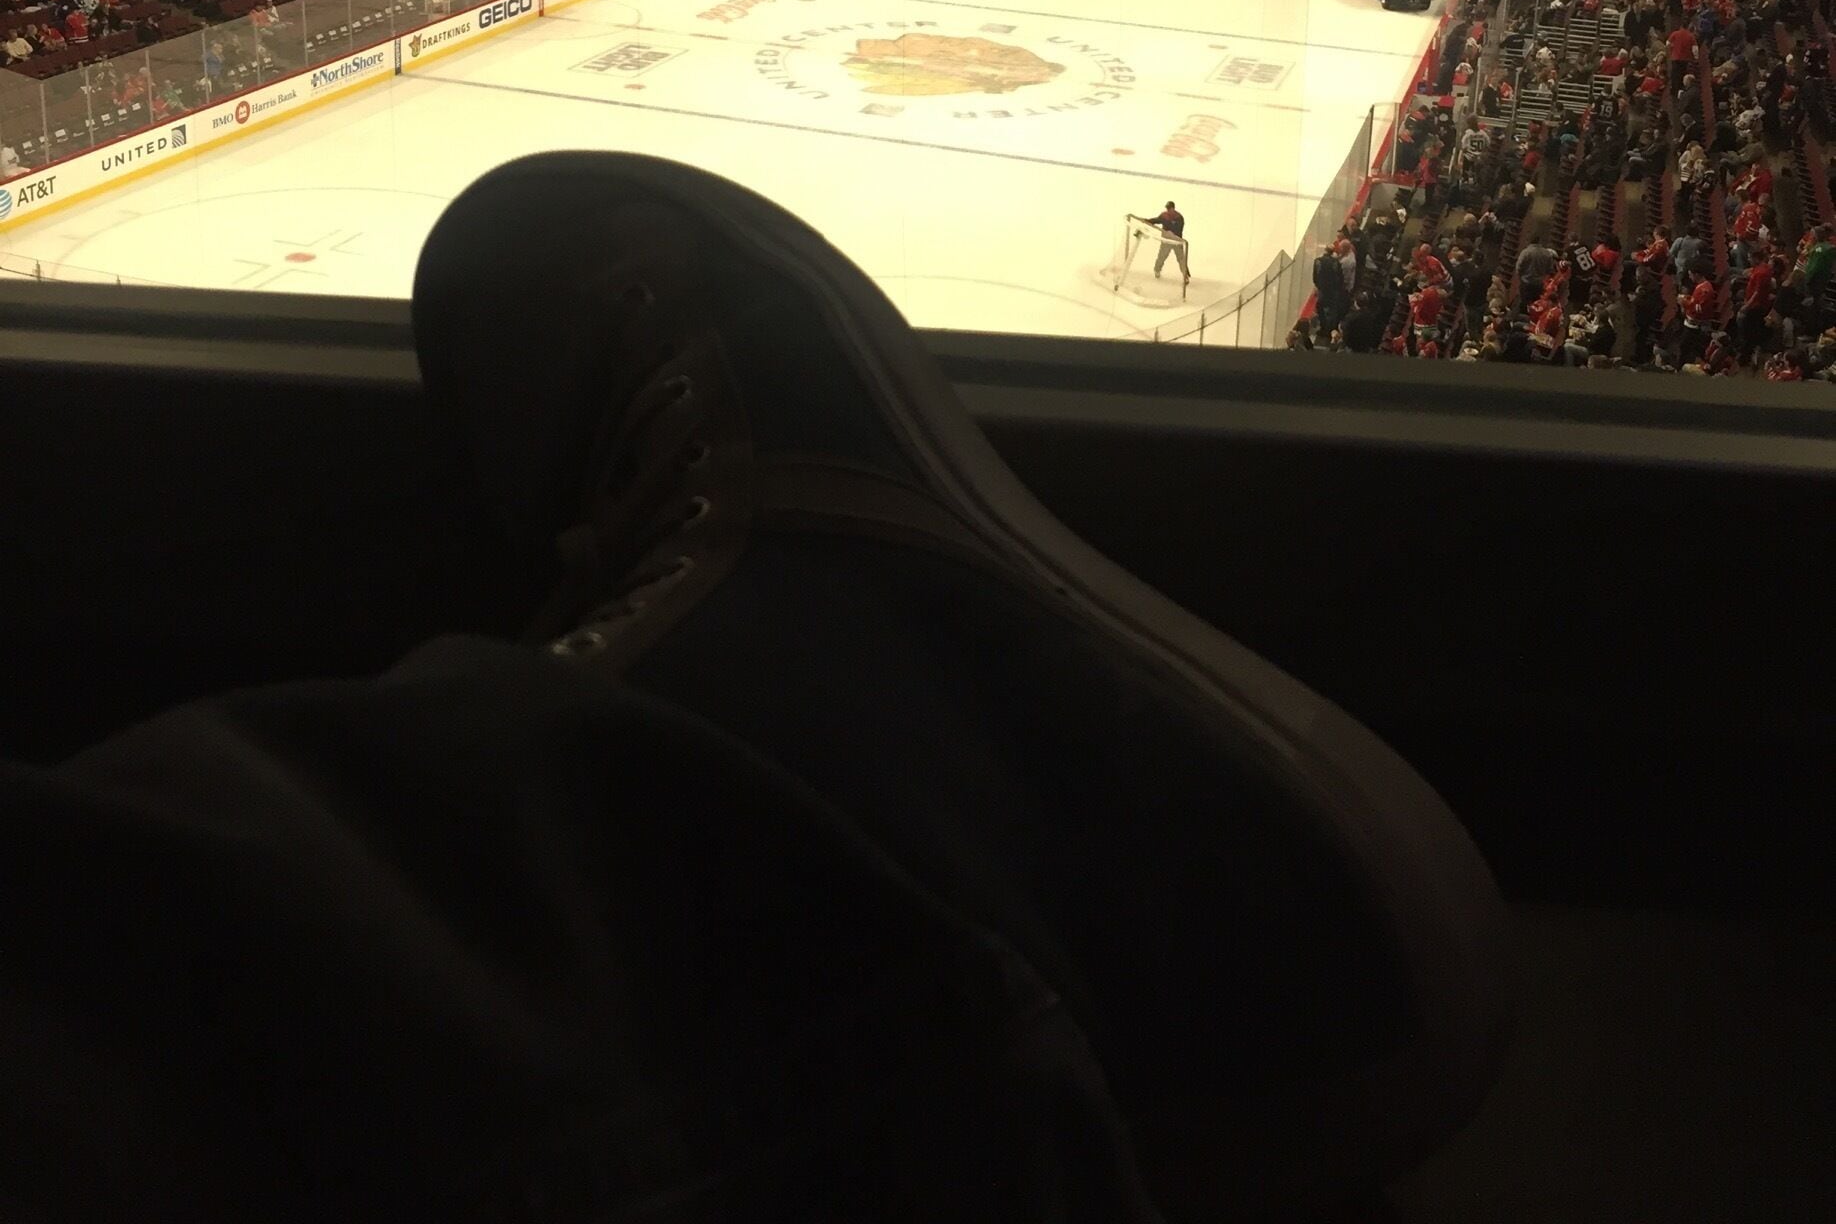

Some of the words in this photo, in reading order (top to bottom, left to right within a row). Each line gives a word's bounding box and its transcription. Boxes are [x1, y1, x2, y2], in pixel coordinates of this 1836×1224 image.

[421, 22, 471, 50] DRAFTKINGS
[318, 50, 384, 86] NorthShore
[1046, 34, 1137, 84] UNITED
[212, 112, 234, 129] BMO
[251, 98, 277, 114] Harris
[277, 89, 298, 105] Bank
[1600, 104, 1613, 117] 19
[101, 137, 168, 172] UNITED
[1470, 138, 1485, 151] 50
[16, 175, 57, 207] AT&T
[1575, 252, 1596, 271] 81
